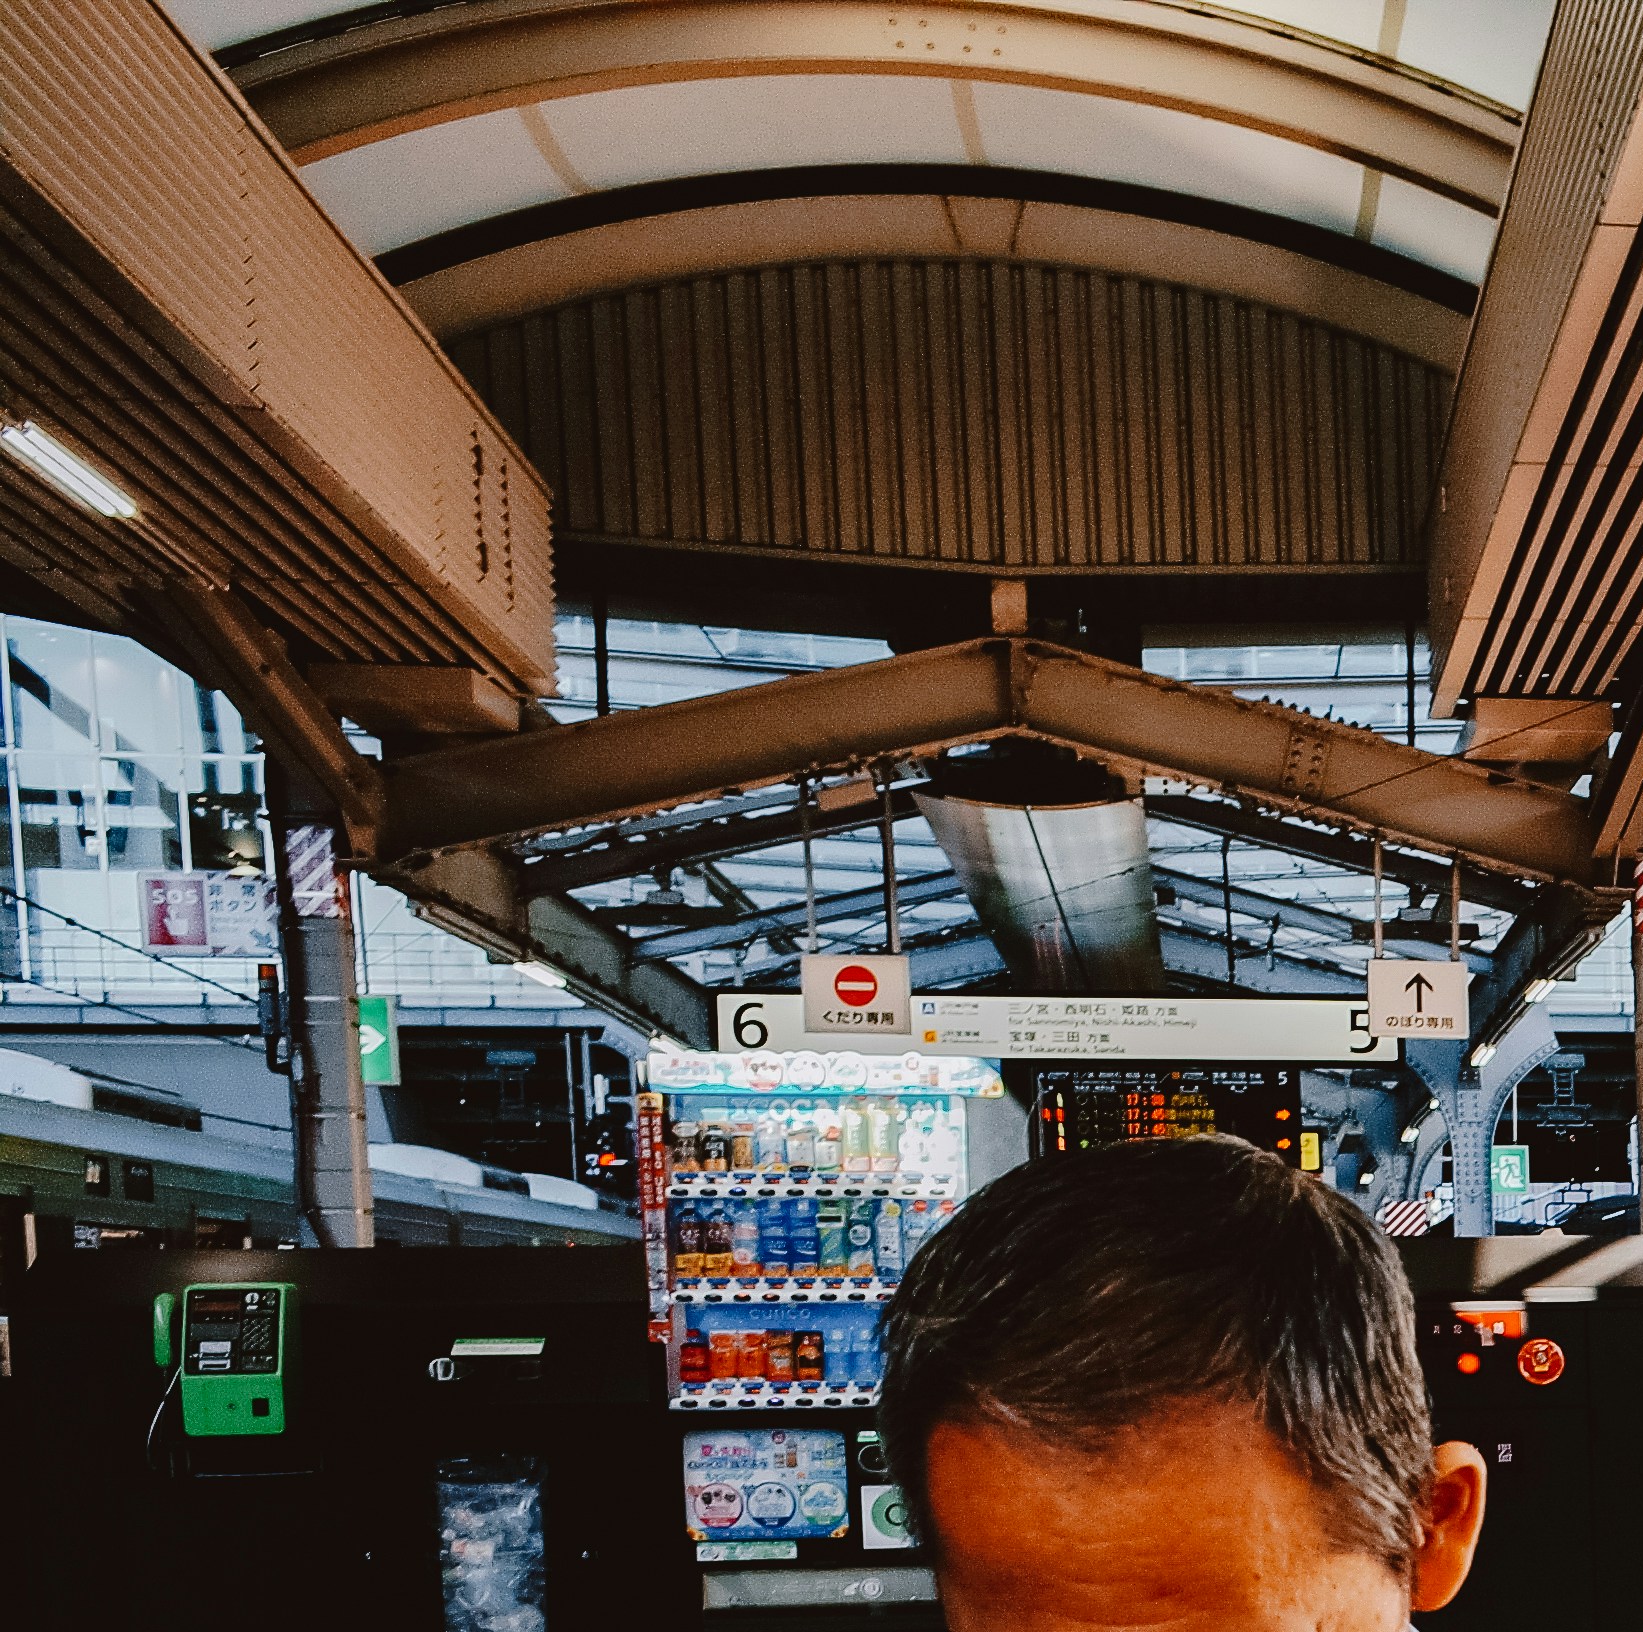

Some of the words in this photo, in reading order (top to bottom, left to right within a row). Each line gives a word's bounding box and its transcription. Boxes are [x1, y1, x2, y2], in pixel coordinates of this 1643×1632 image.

[152, 889, 199, 903] SOS
[733, 1002, 769, 1049] 6
[822, 1010, 894, 1026] くだり専用
[1385, 1015, 1455, 1030] のぼり専用
[1349, 1008, 1379, 1054] 5
[1277, 1071, 1289, 1085] 5
